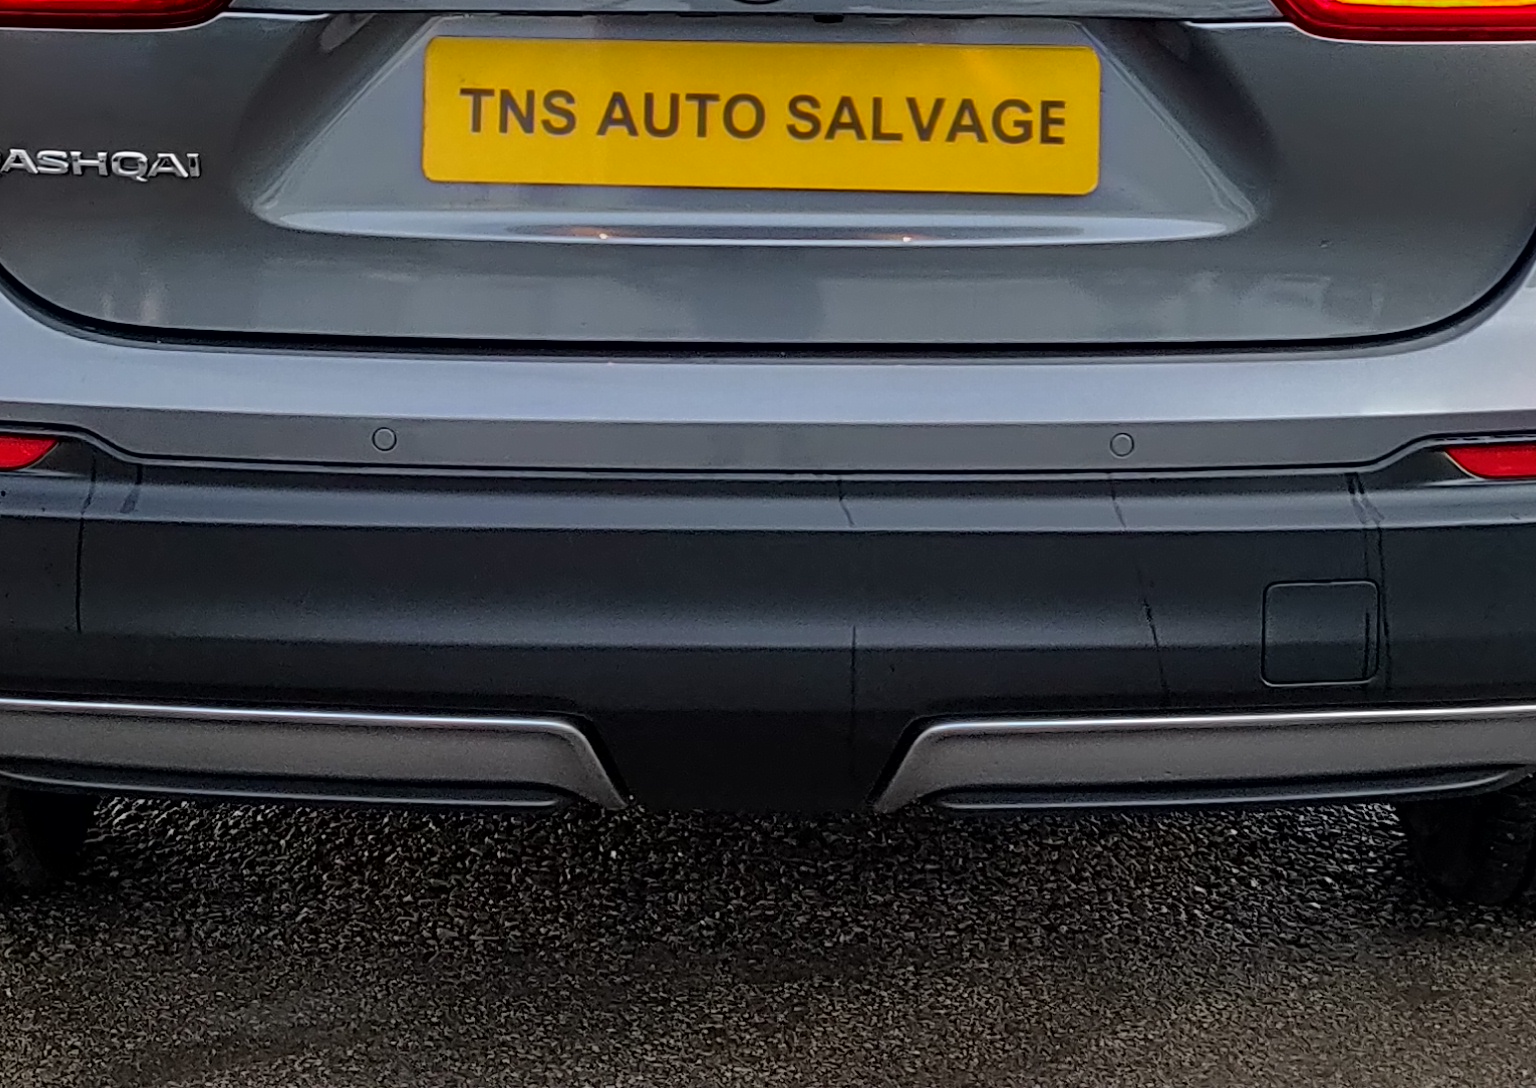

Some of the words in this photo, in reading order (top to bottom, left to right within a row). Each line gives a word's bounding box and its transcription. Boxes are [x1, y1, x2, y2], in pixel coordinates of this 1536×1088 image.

[460, 88, 576, 135] TNS
[596, 92, 765, 138] AUTO
[786, 94, 1066, 145] SALVAGE
